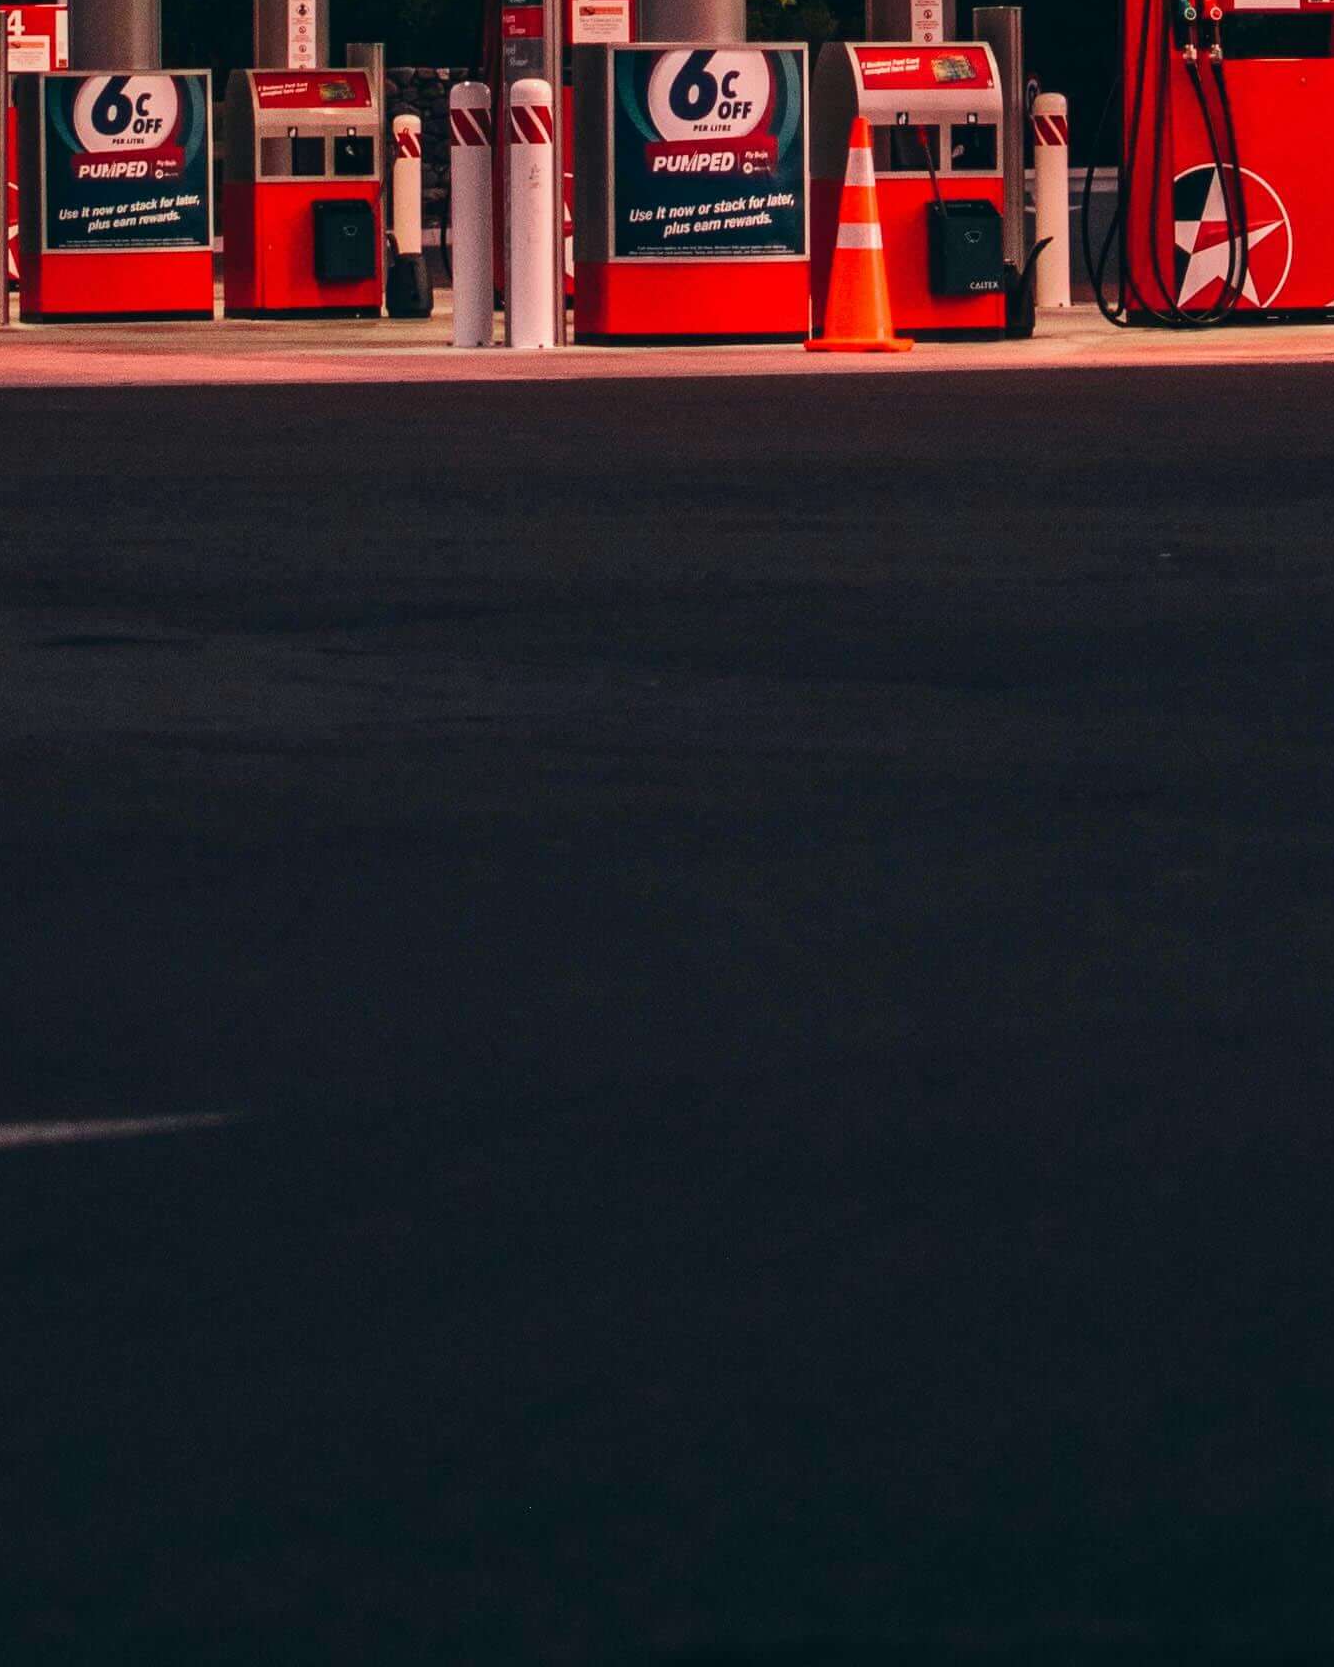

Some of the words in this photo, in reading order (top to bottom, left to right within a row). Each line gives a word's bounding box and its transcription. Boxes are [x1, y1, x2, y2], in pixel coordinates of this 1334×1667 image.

[7, 10, 26, 36] 4
[718, 101, 753, 120] OFF
[133, 118, 163, 134] OFF
[78, 160, 149, 179] PUMPED
[652, 150, 736, 172] PUMPED
[629, 207, 653, 223] Use
[656, 205, 668, 220] it
[669, 205, 696, 218] now
[698, 202, 713, 215] or
[714, 197, 747, 213] stack
[748, 195, 766, 210] for
[766, 192, 796, 208] later,
[663, 221, 691, 239] plus
[693, 220, 721, 234] earn
[723, 214, 773, 230] rewards.
